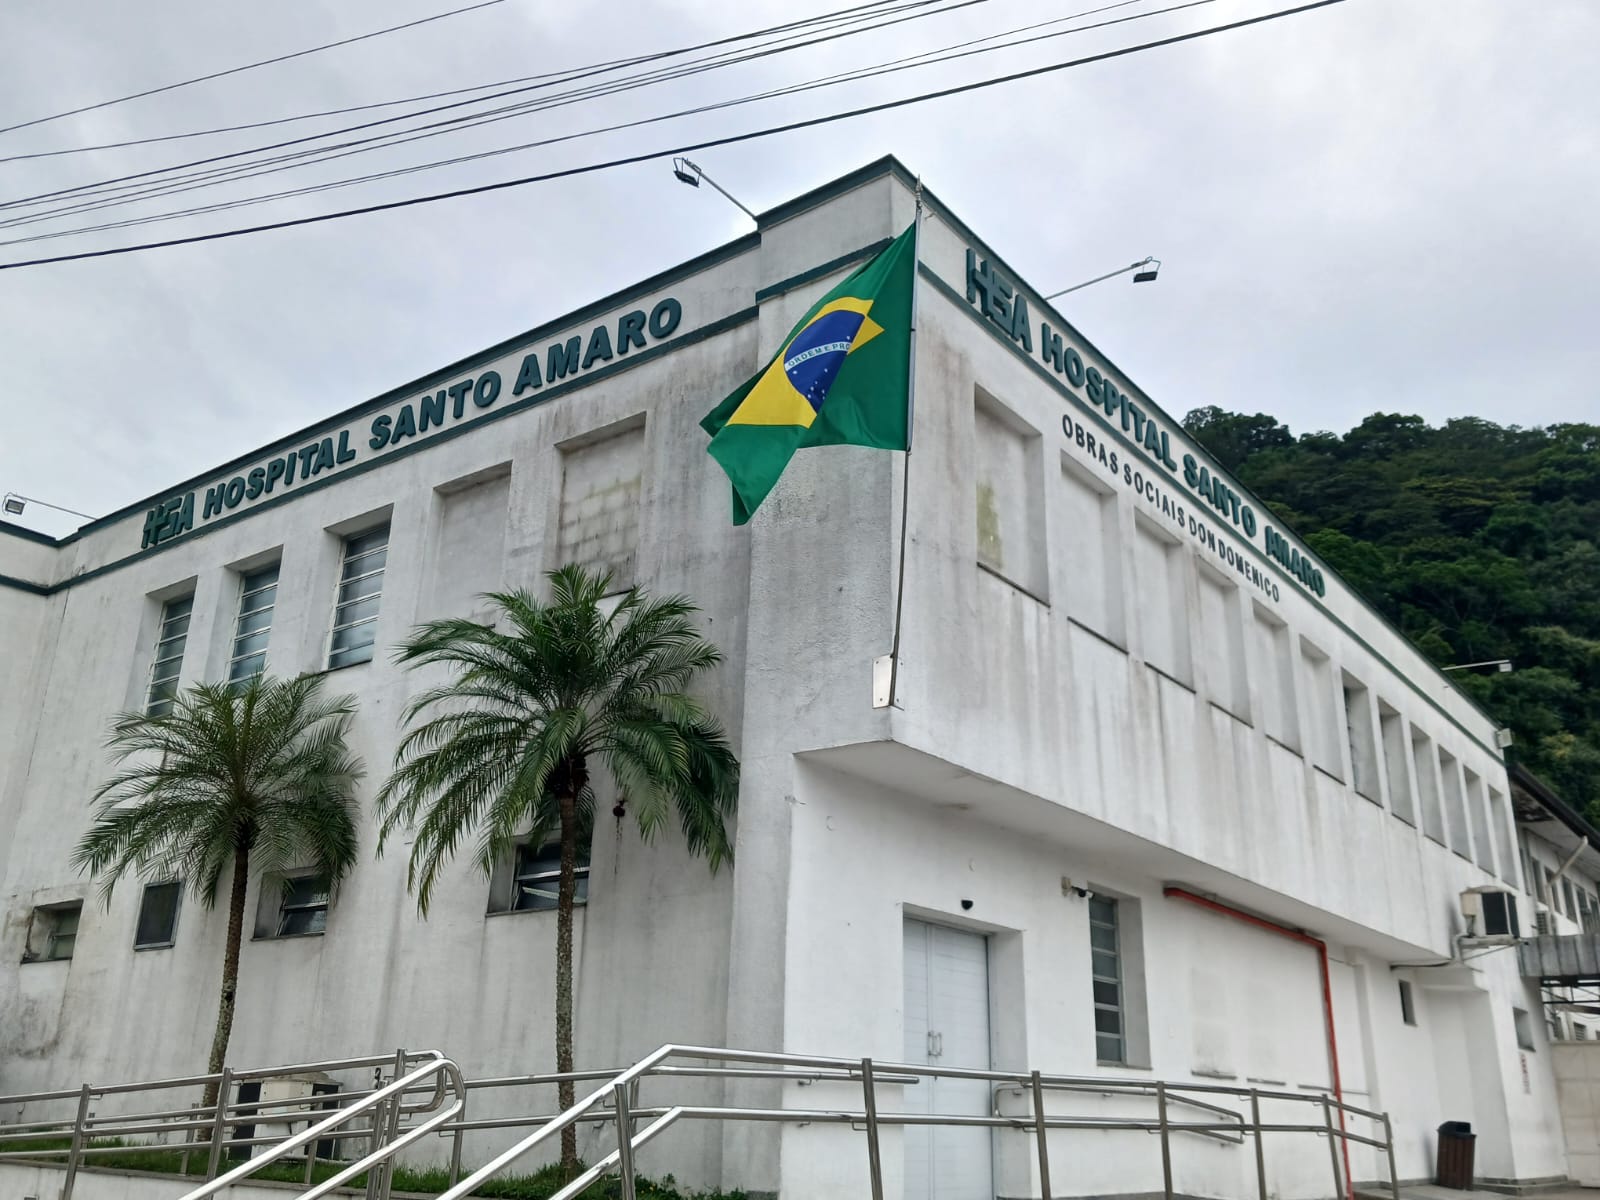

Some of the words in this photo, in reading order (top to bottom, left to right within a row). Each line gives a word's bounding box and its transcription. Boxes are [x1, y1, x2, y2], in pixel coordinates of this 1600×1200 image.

[202, 430, 356, 520] HOSPITAL
[369, 370, 502, 450] SANTO
[512, 298, 683, 395] AMARO
[788, 347, 822, 367] ORDEM
[966, 248, 1033, 353] HSA
[1041, 322, 1178, 473] HOSPITAL
[1183, 453, 1257, 538] SANTO
[1265, 525, 1326, 599] AMARO
[1062, 414, 1119, 475] OBRAS
[1123, 463, 1186, 528] SOCIAIS
[1189, 514, 1216, 553] DON
[1218, 538, 1280, 603] DOMENICO
